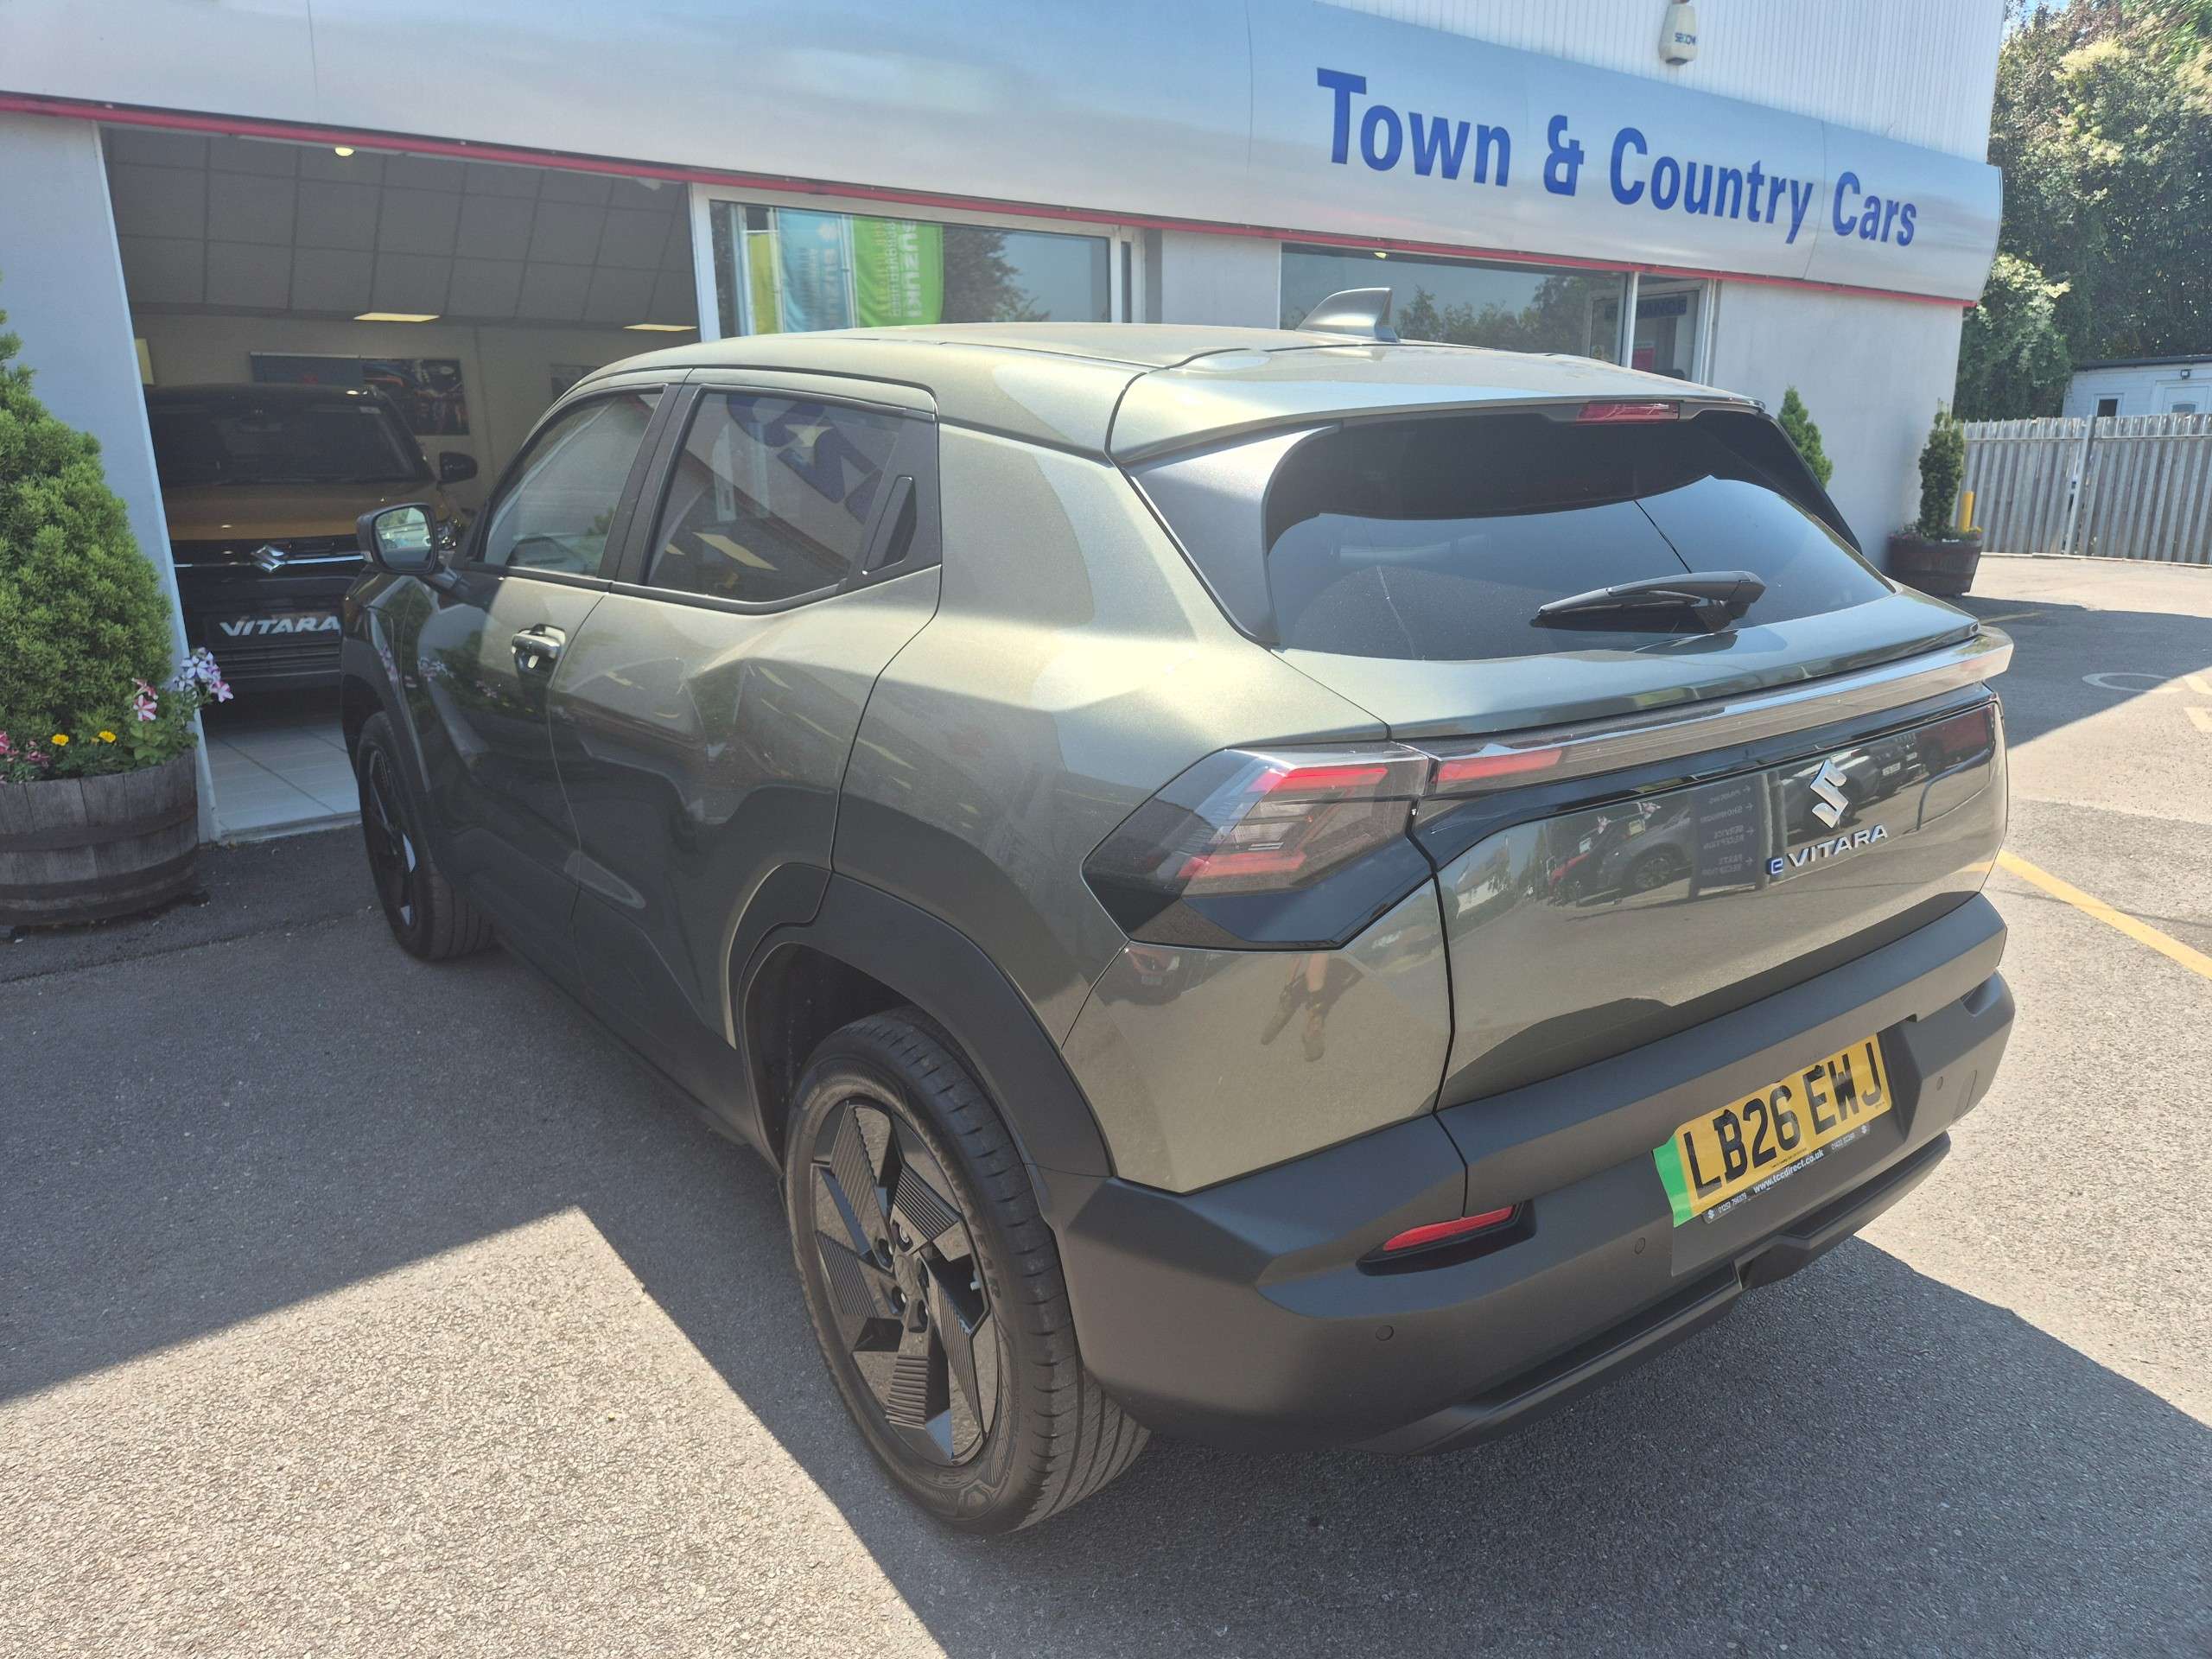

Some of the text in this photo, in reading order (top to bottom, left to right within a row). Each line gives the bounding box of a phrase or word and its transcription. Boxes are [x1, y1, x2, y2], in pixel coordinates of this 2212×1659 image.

[1316, 67, 1917, 247] Town & Country Cars
[219, 615, 340, 637] VITARA
[1787, 824, 1888, 868] VITARA
[1683, 1042, 1882, 1199] LB26 EWJ
[1752, 1148, 1824, 1194] www.tccdirect.co.uk
